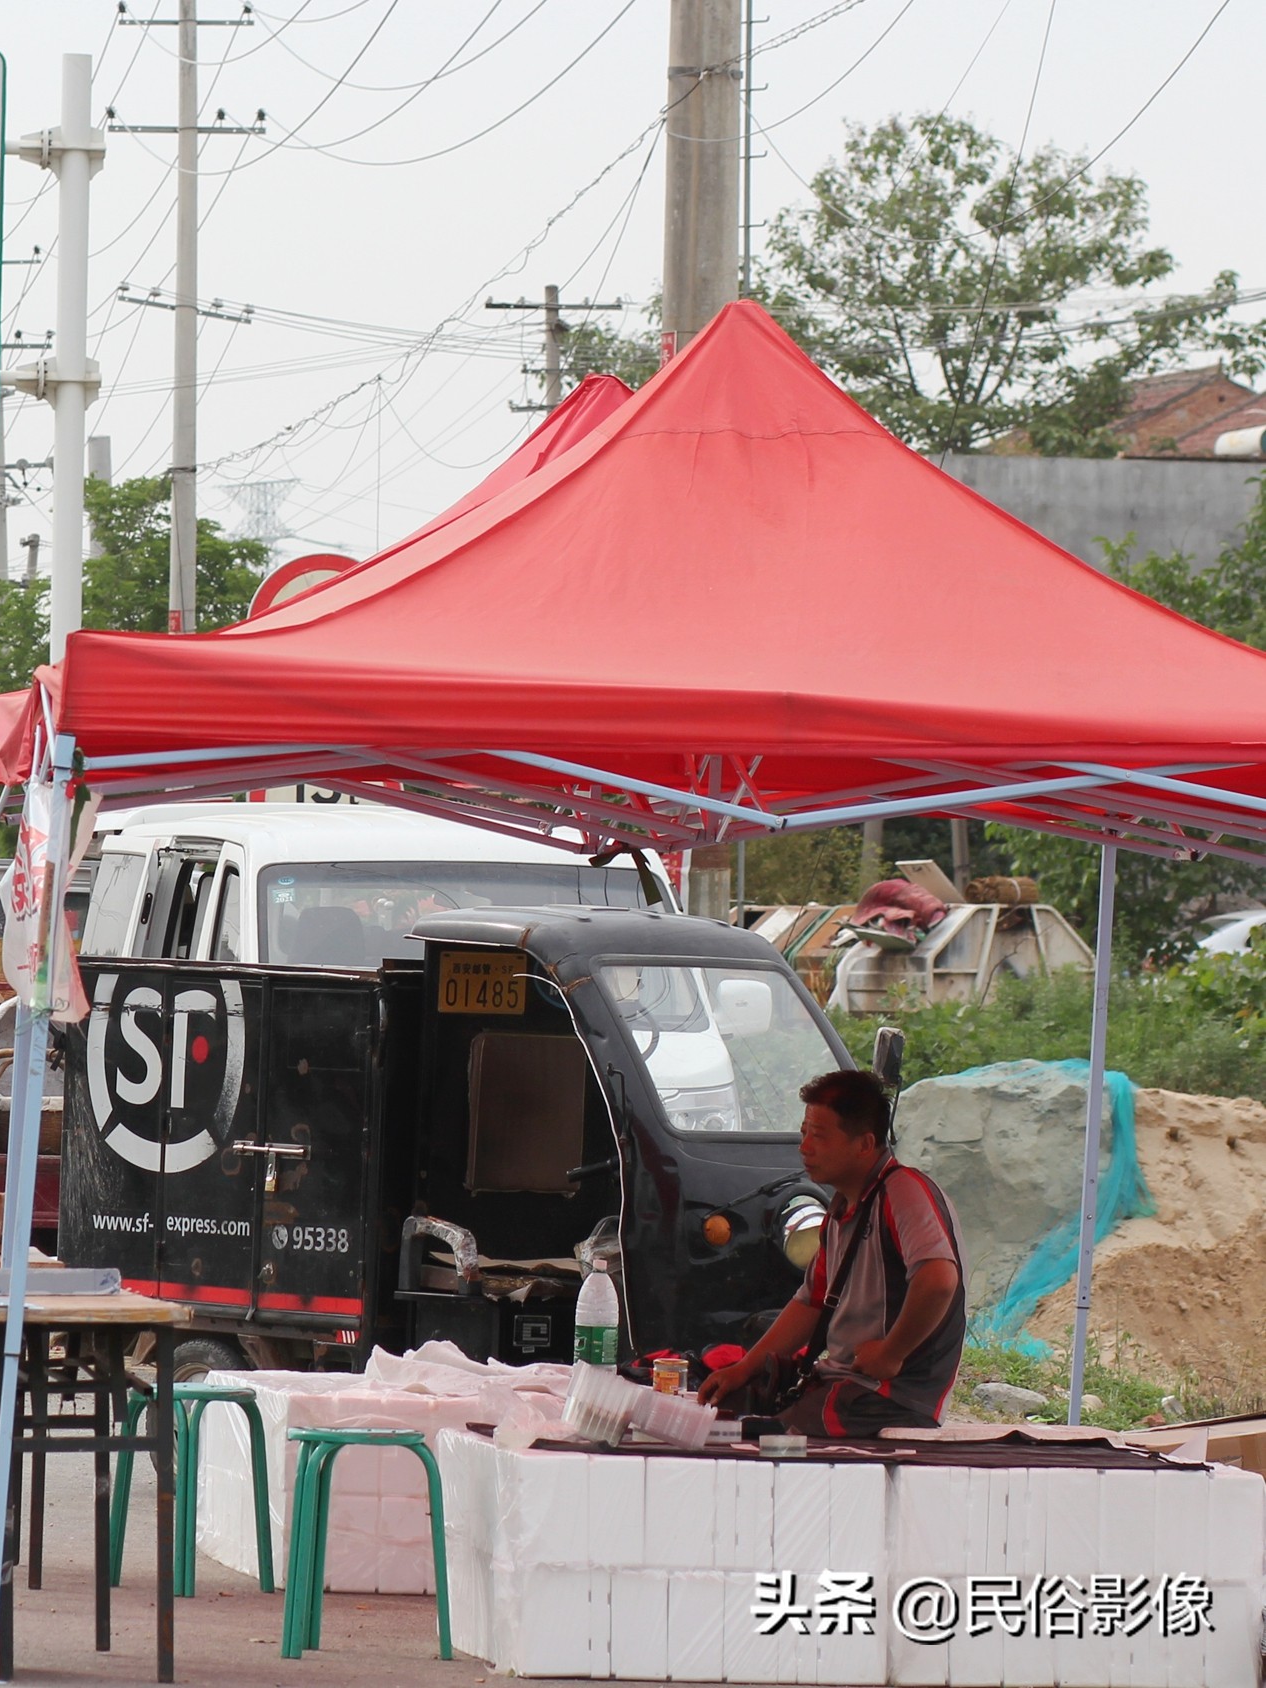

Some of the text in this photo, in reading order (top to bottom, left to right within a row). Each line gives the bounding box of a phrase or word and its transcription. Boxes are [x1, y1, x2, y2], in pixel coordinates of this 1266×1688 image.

[445, 979, 520, 1009] 01485
[166, 1214, 250, 1237] express.com
[292, 1226, 349, 1253] 95338
